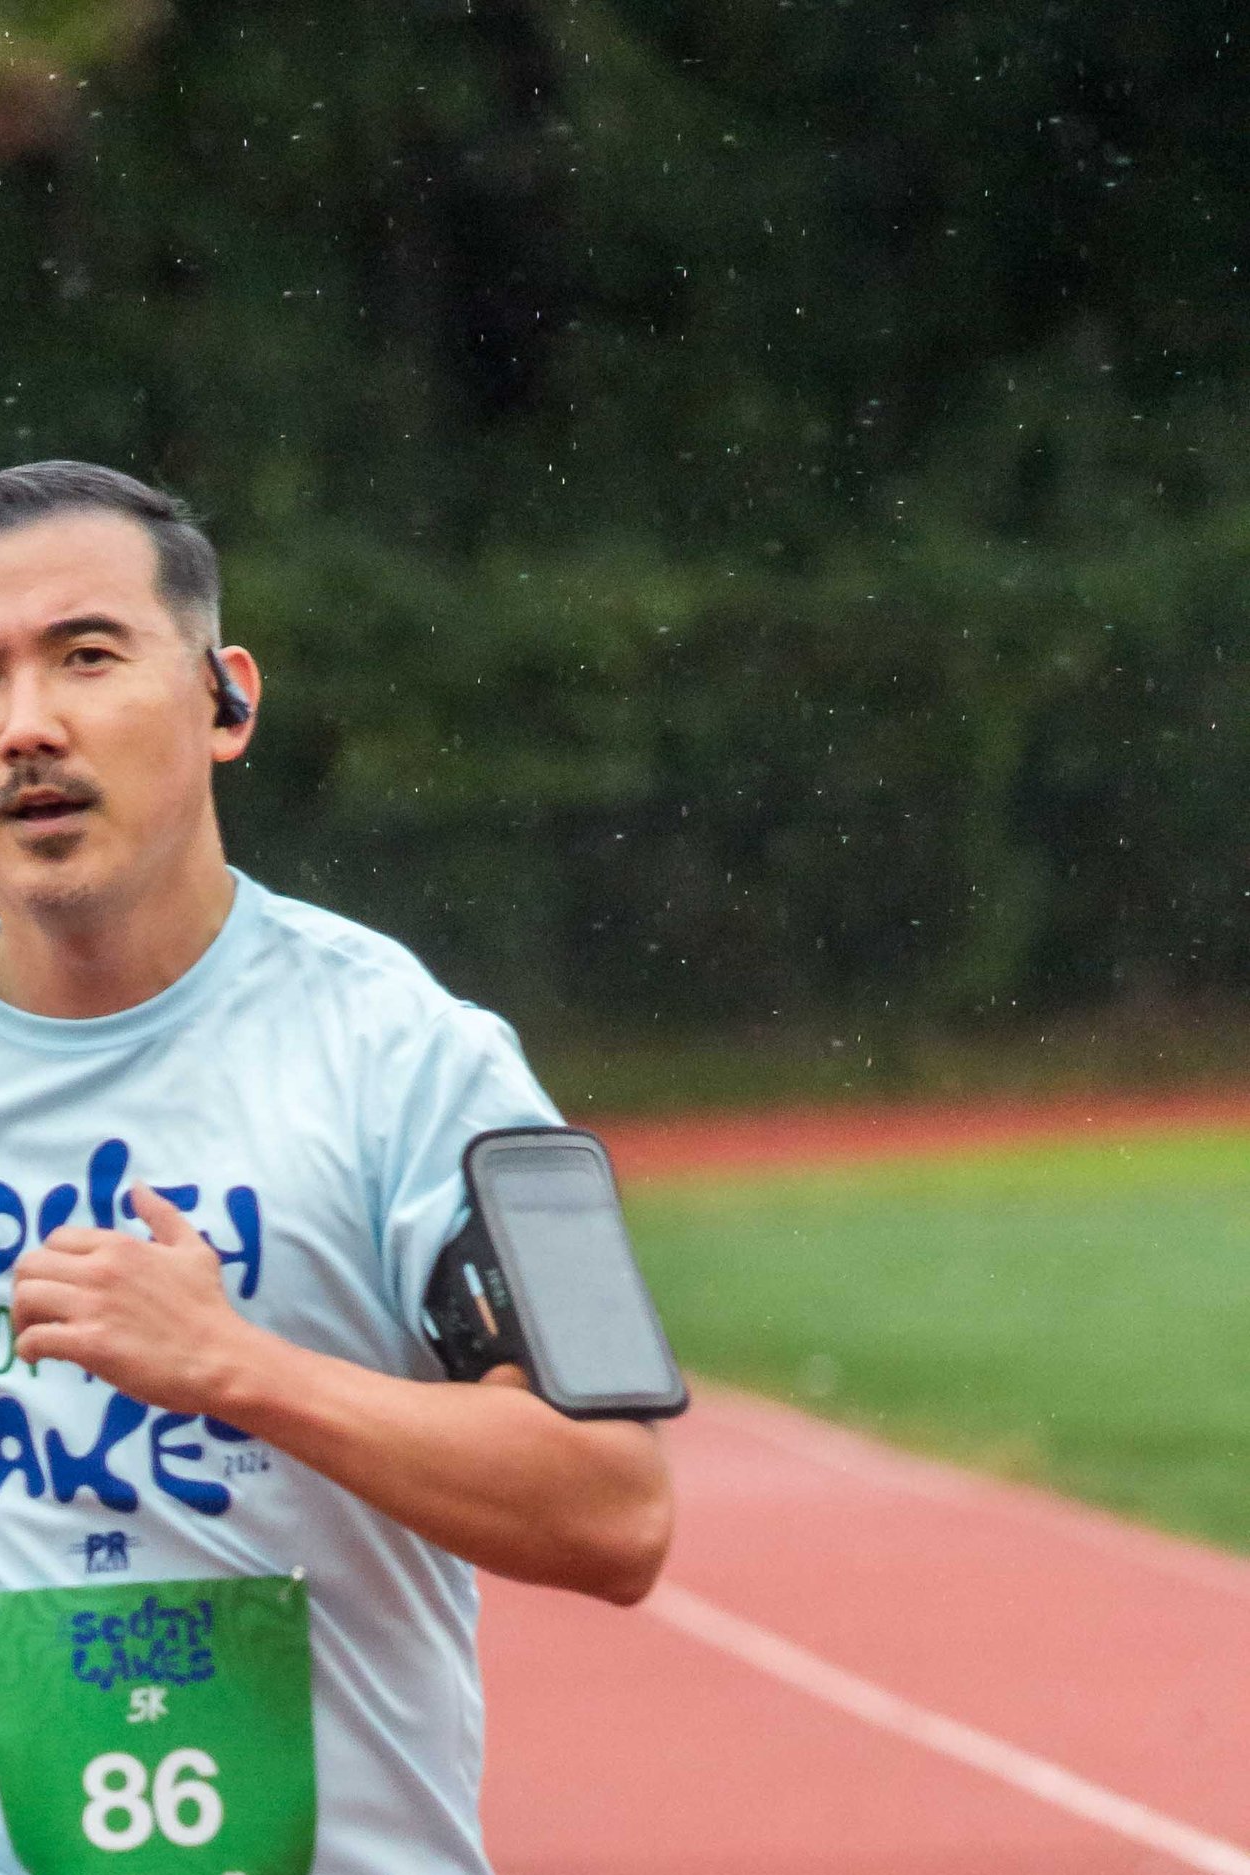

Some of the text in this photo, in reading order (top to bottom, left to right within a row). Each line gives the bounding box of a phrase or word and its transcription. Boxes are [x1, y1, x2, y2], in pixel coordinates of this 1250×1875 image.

[85, 1531, 129, 1560] PR
[71, 1641, 216, 1690] LAKES
[126, 1685, 169, 1724] 5K
[81, 1747, 224, 1852] 86
